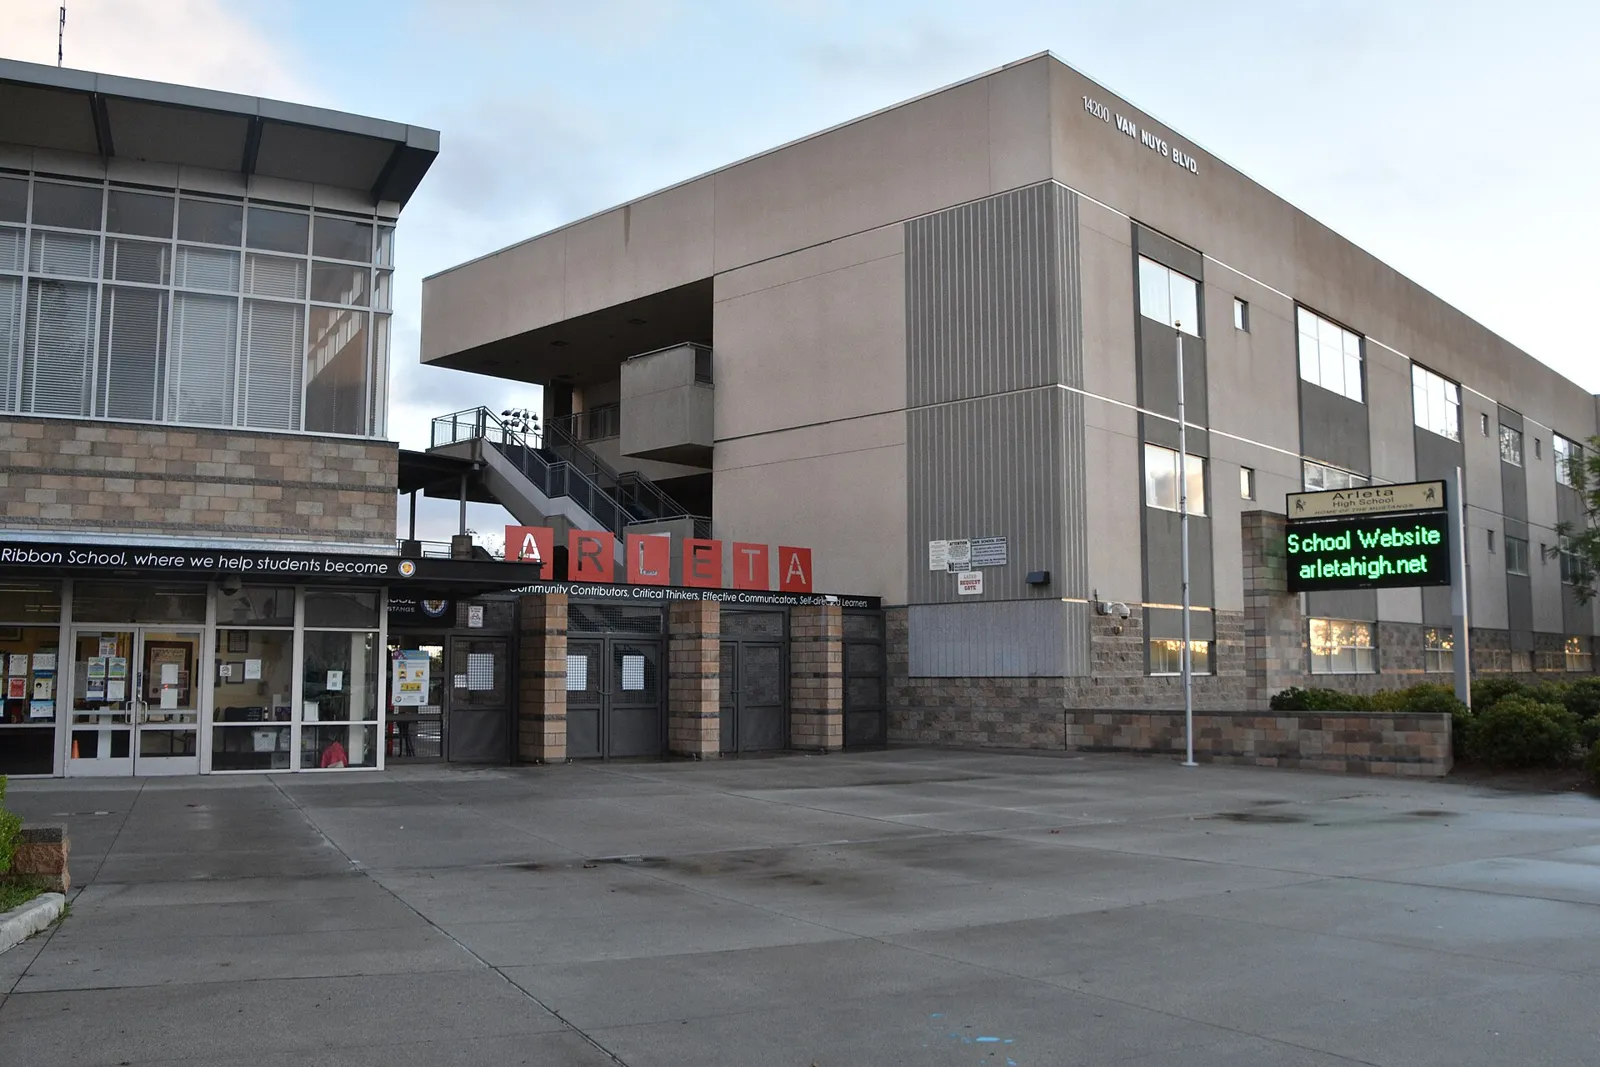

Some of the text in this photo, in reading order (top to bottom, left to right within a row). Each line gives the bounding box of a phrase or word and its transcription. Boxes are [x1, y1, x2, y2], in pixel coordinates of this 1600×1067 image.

[1082, 96, 1199, 175] 14200 VAN NUYS BLVD.
[1332, 488, 1394, 501] Arleta
[1333, 497, 1394, 509] High School
[1287, 525, 1441, 554] School Website
[1, 548, 388, 574] Ribbon School, where we help students become
[1299, 554, 1428, 580] arletahigh.net
[570, 584, 630, 597] Contributors,
[632, 587, 664, 599] Critical
[665, 589, 700, 601] Thinkers,
[702, 591, 737, 602] Effective
[738, 592, 798, 605] Communicators,
[842, 598, 868, 608] Learners
